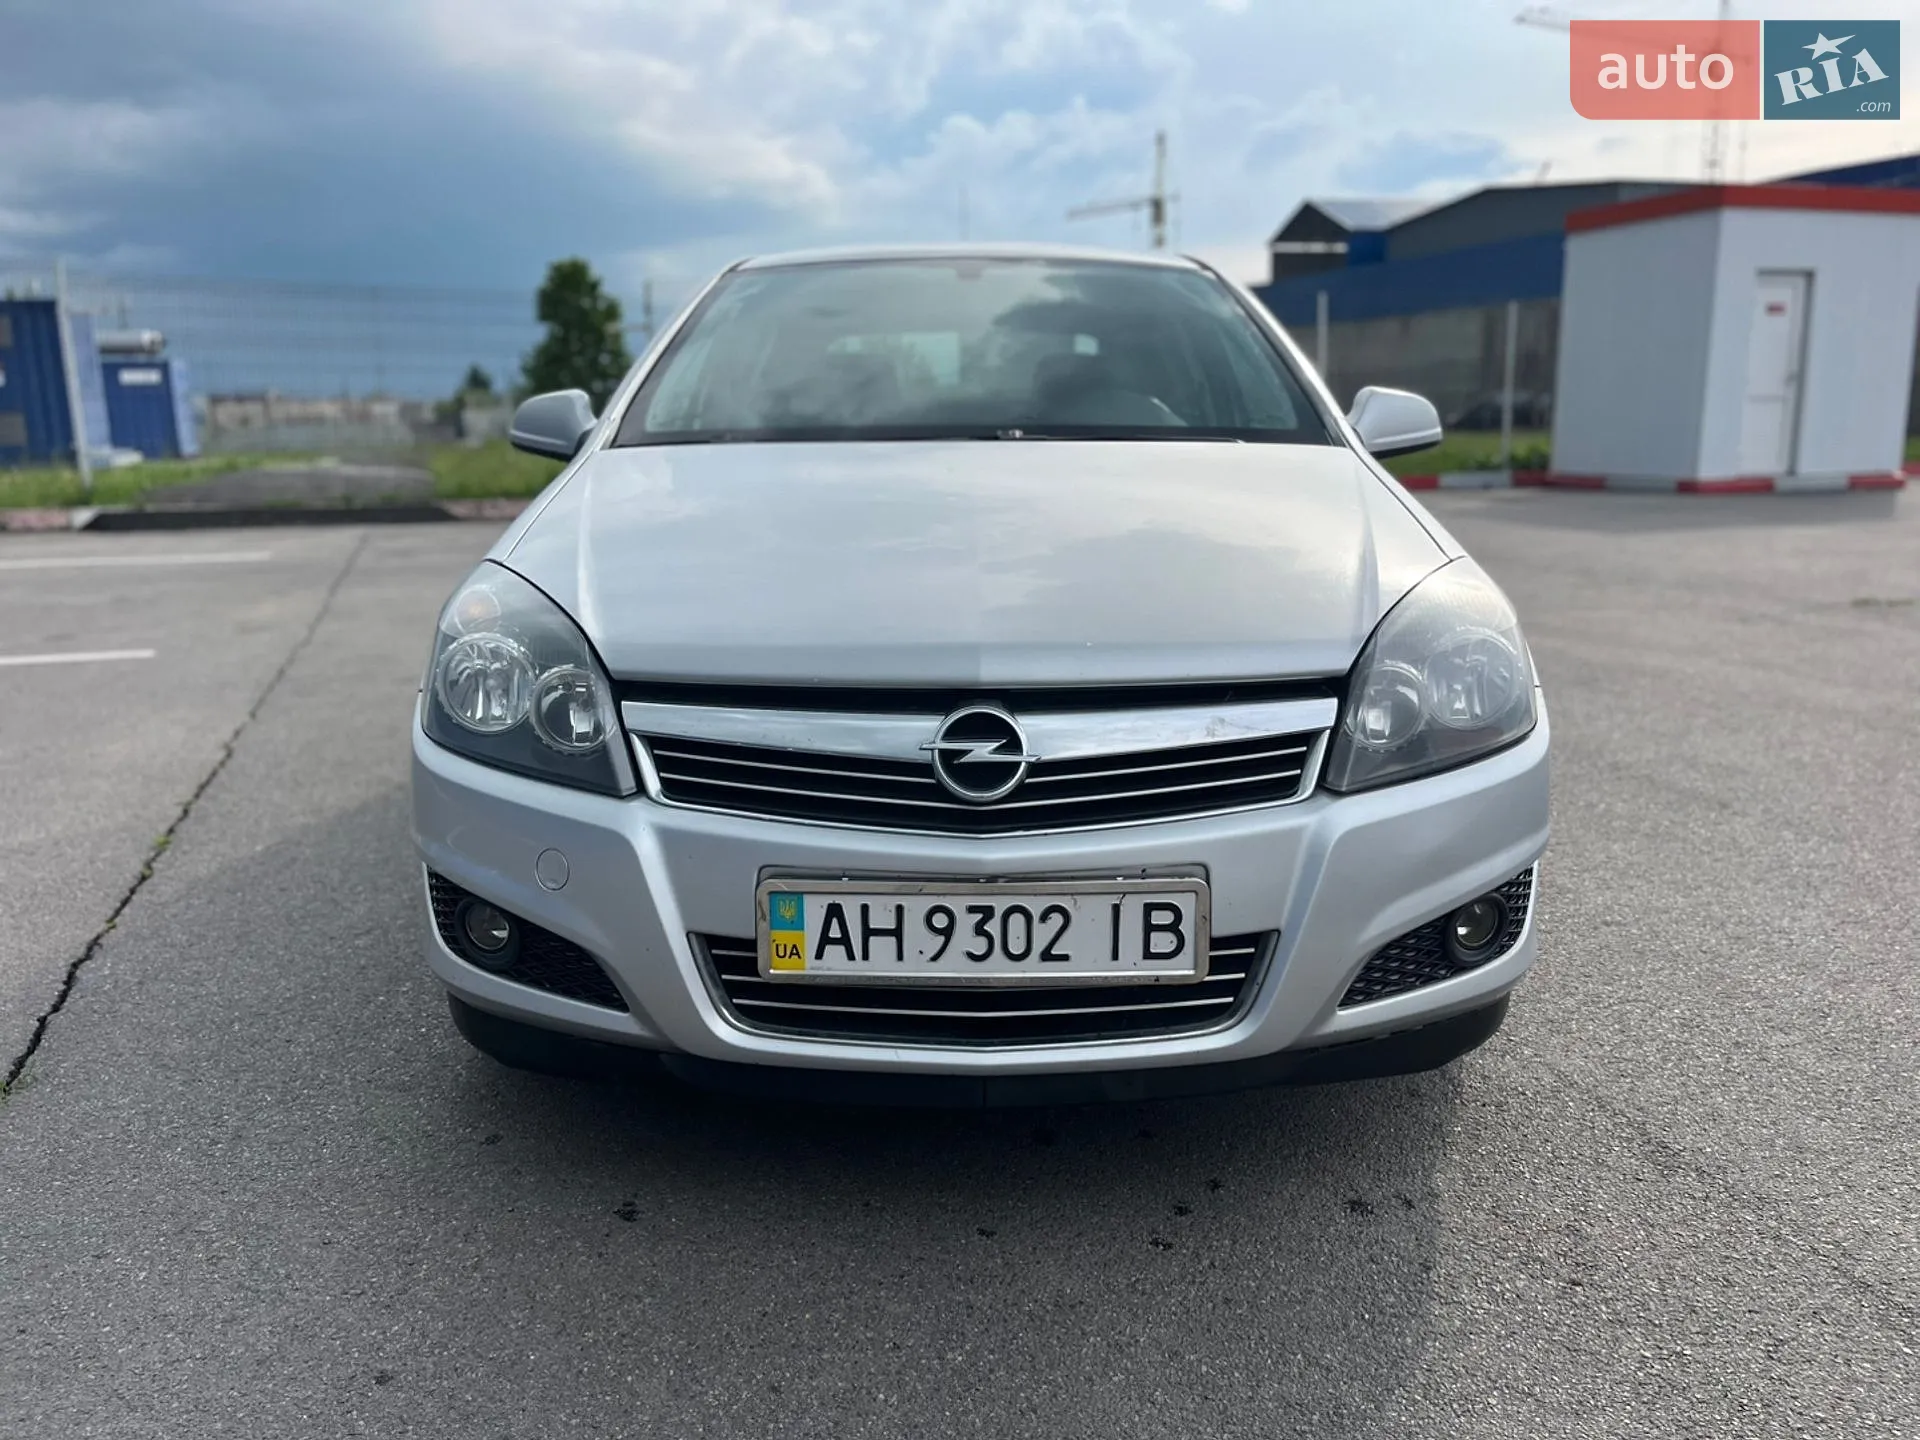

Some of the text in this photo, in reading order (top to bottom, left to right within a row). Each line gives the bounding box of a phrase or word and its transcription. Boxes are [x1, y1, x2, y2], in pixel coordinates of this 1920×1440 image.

[774, 944, 802, 960] UA
[814, 900, 1187, 964] AH 9302 IB
